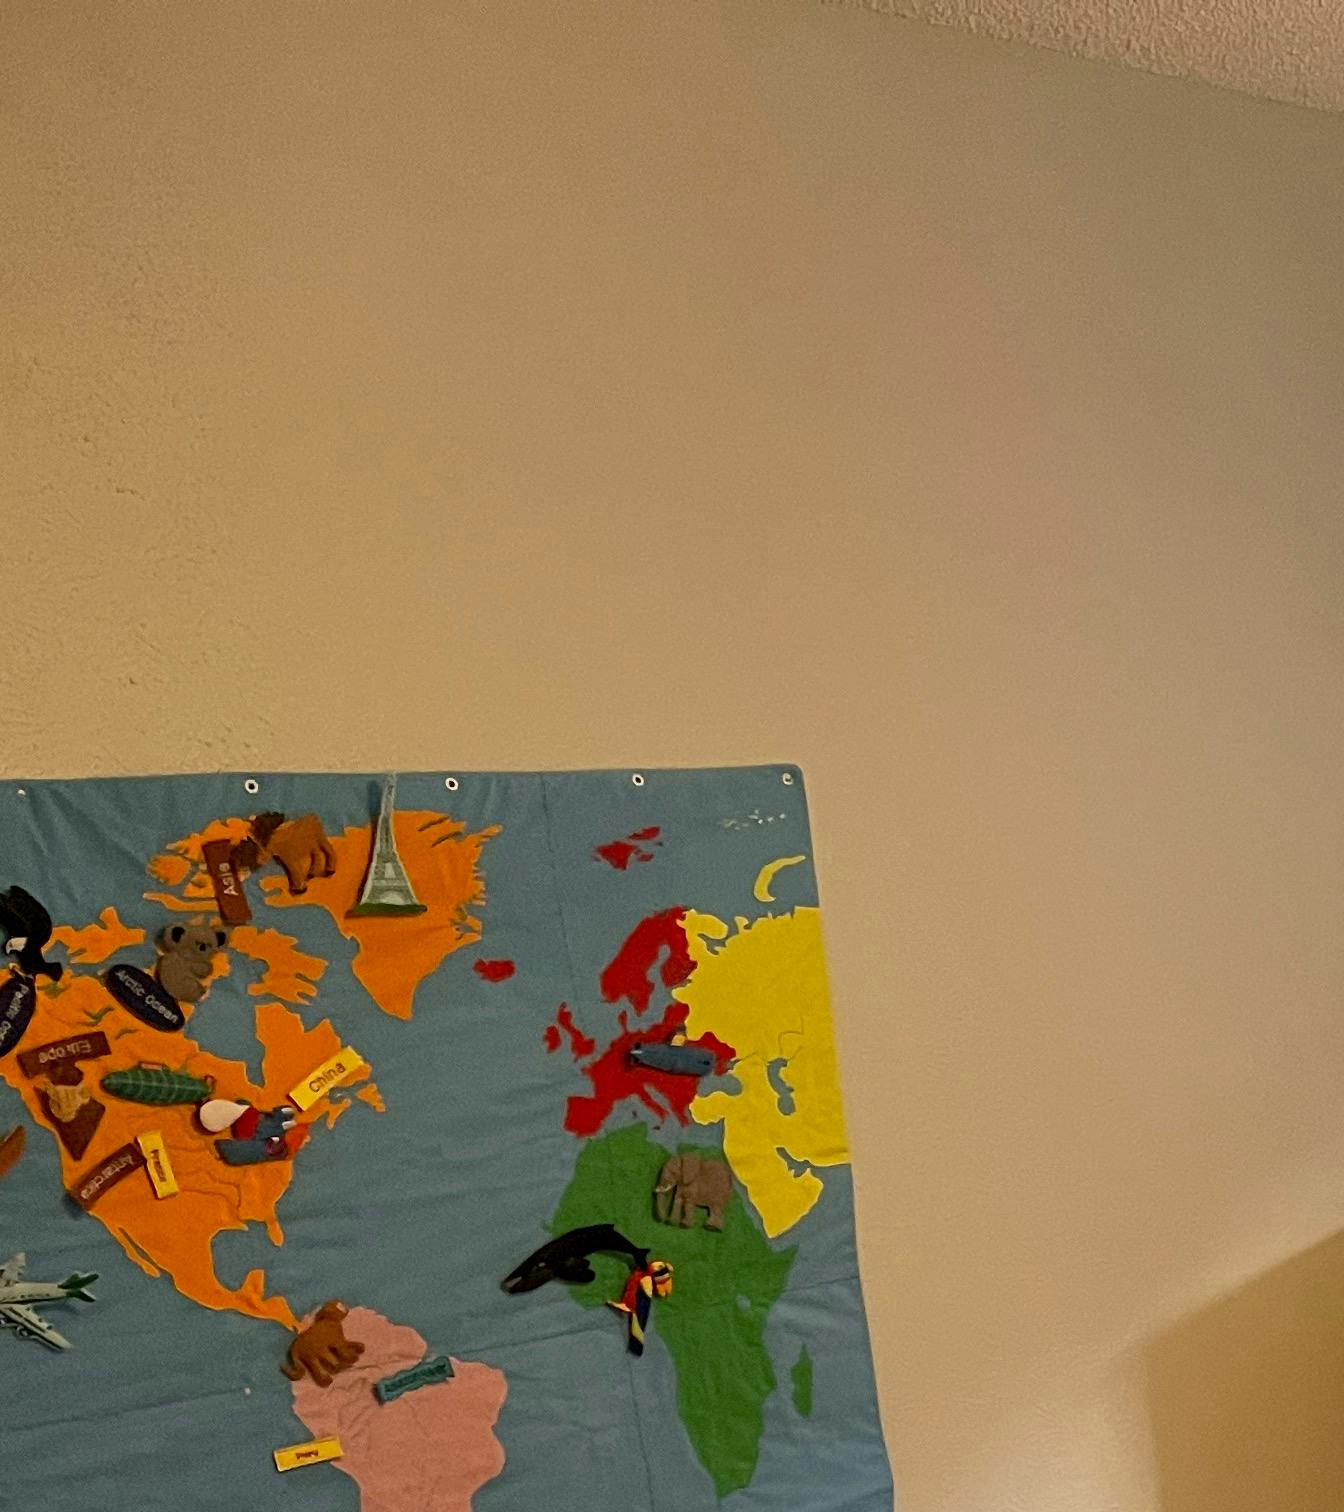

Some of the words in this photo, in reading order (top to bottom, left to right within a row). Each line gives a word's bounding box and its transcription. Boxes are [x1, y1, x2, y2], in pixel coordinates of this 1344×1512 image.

[219, 862, 239, 896] Asia
[114, 969, 145, 997] Arctic
[145, 994, 179, 1024] Ocean
[309, 1063, 345, 1092] China
